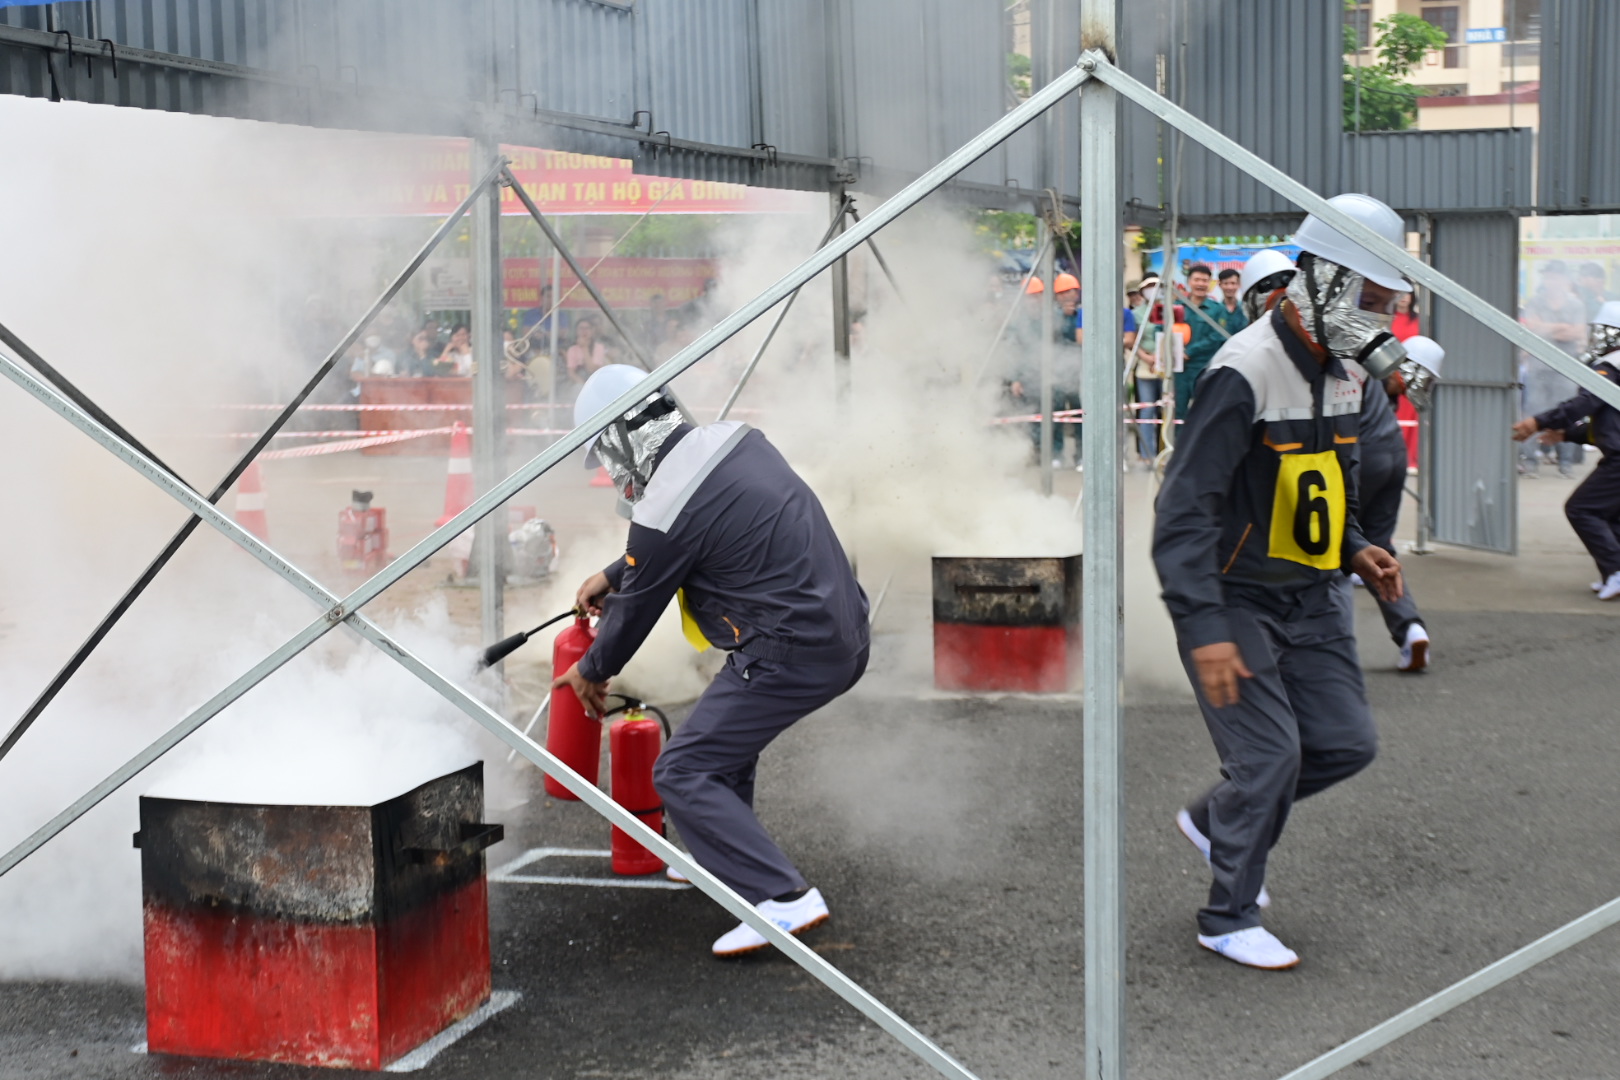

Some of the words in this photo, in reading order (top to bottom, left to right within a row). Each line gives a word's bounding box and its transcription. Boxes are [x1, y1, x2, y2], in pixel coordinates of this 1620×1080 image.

[421, 179, 449, 203] VÀ
[572, 182, 606, 206] TẠI
[612, 178, 642, 205] HỘ
[647, 181, 686, 201] GIA
[1293, 469, 1330, 556] 6
